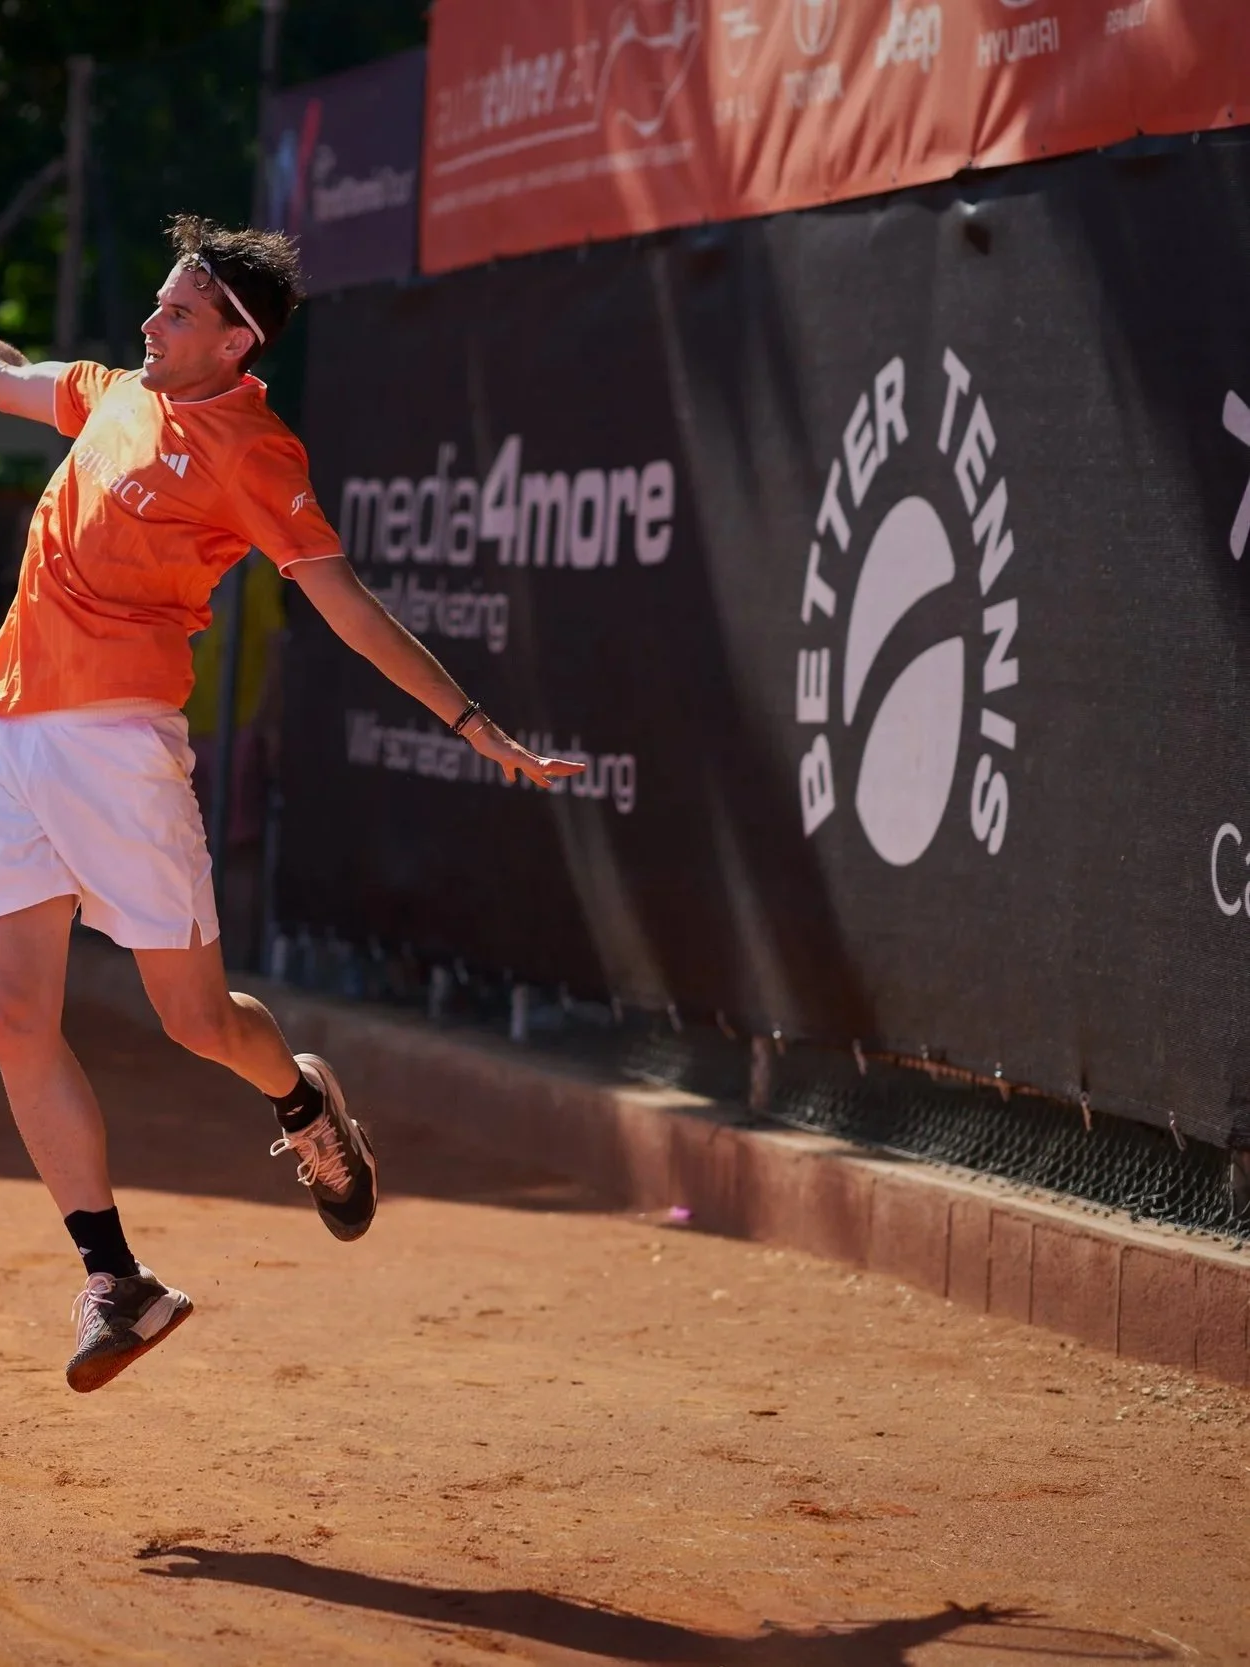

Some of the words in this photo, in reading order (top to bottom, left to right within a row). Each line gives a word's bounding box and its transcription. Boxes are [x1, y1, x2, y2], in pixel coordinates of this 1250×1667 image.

[874, 0, 943, 73] Jeep
[340, 434, 674, 570] media4more
[796, 354, 910, 838] BETTER
[936, 346, 1019, 857] TENNIS
